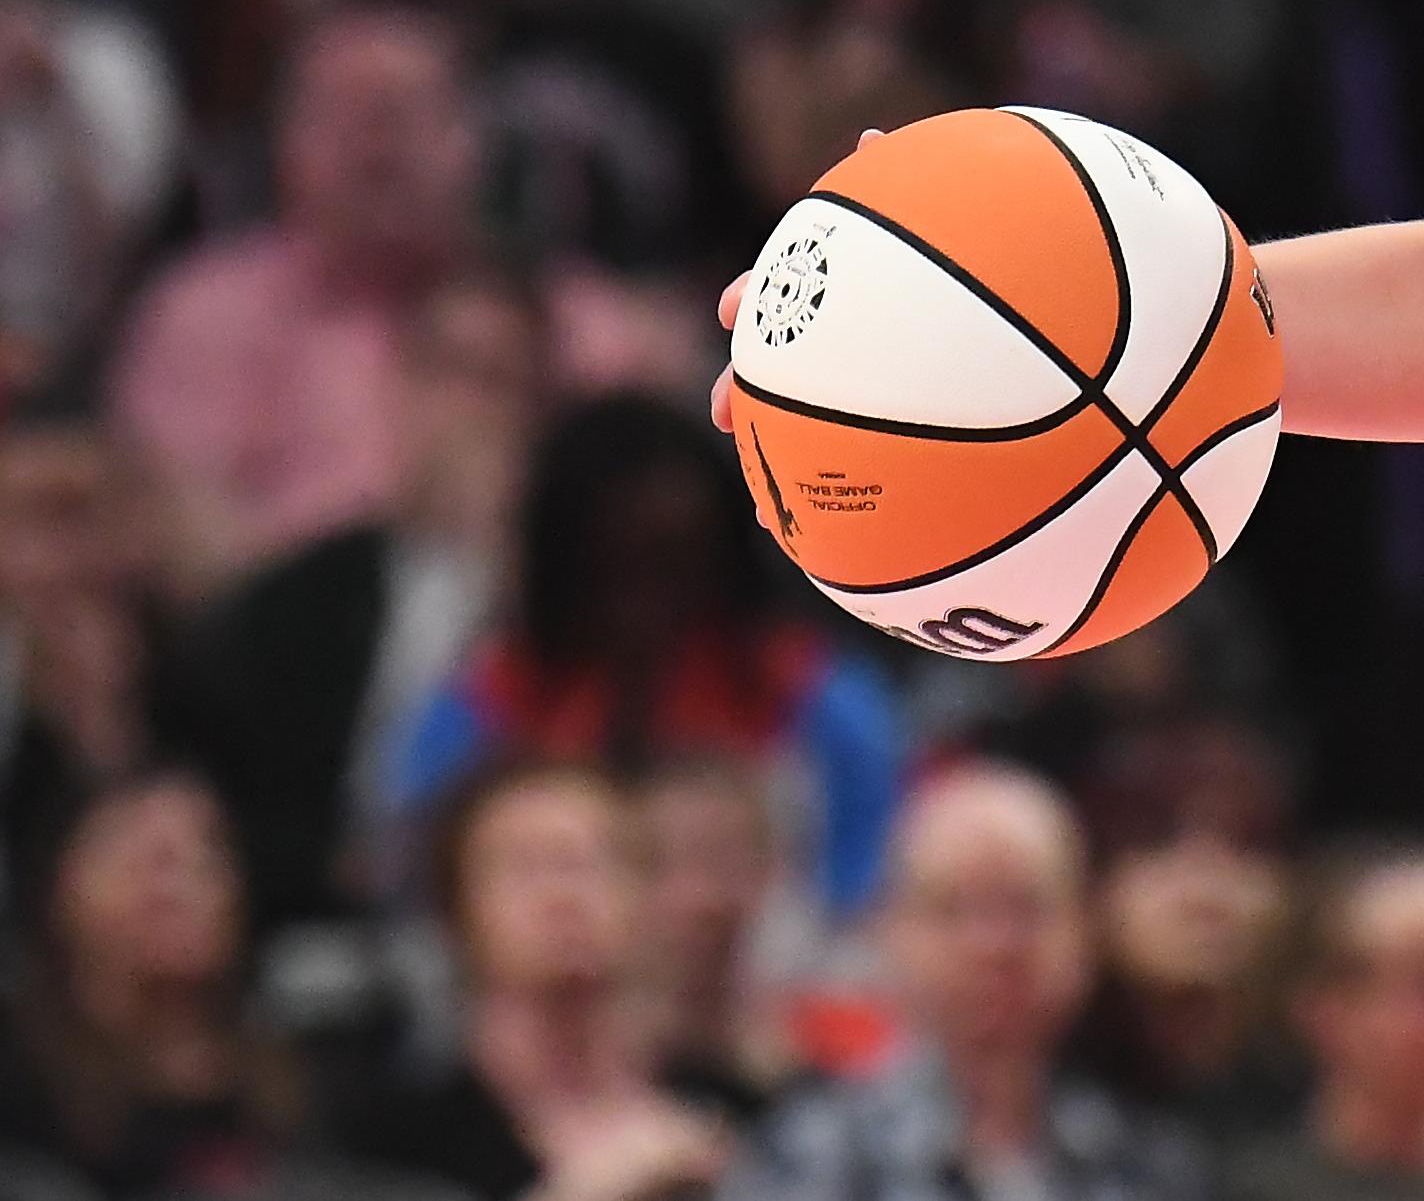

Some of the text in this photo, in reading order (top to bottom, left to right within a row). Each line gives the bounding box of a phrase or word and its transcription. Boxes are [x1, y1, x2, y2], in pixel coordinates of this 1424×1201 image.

[795, 481, 883, 497] GAME BALL
[808, 499, 877, 512] OFFICIAL
